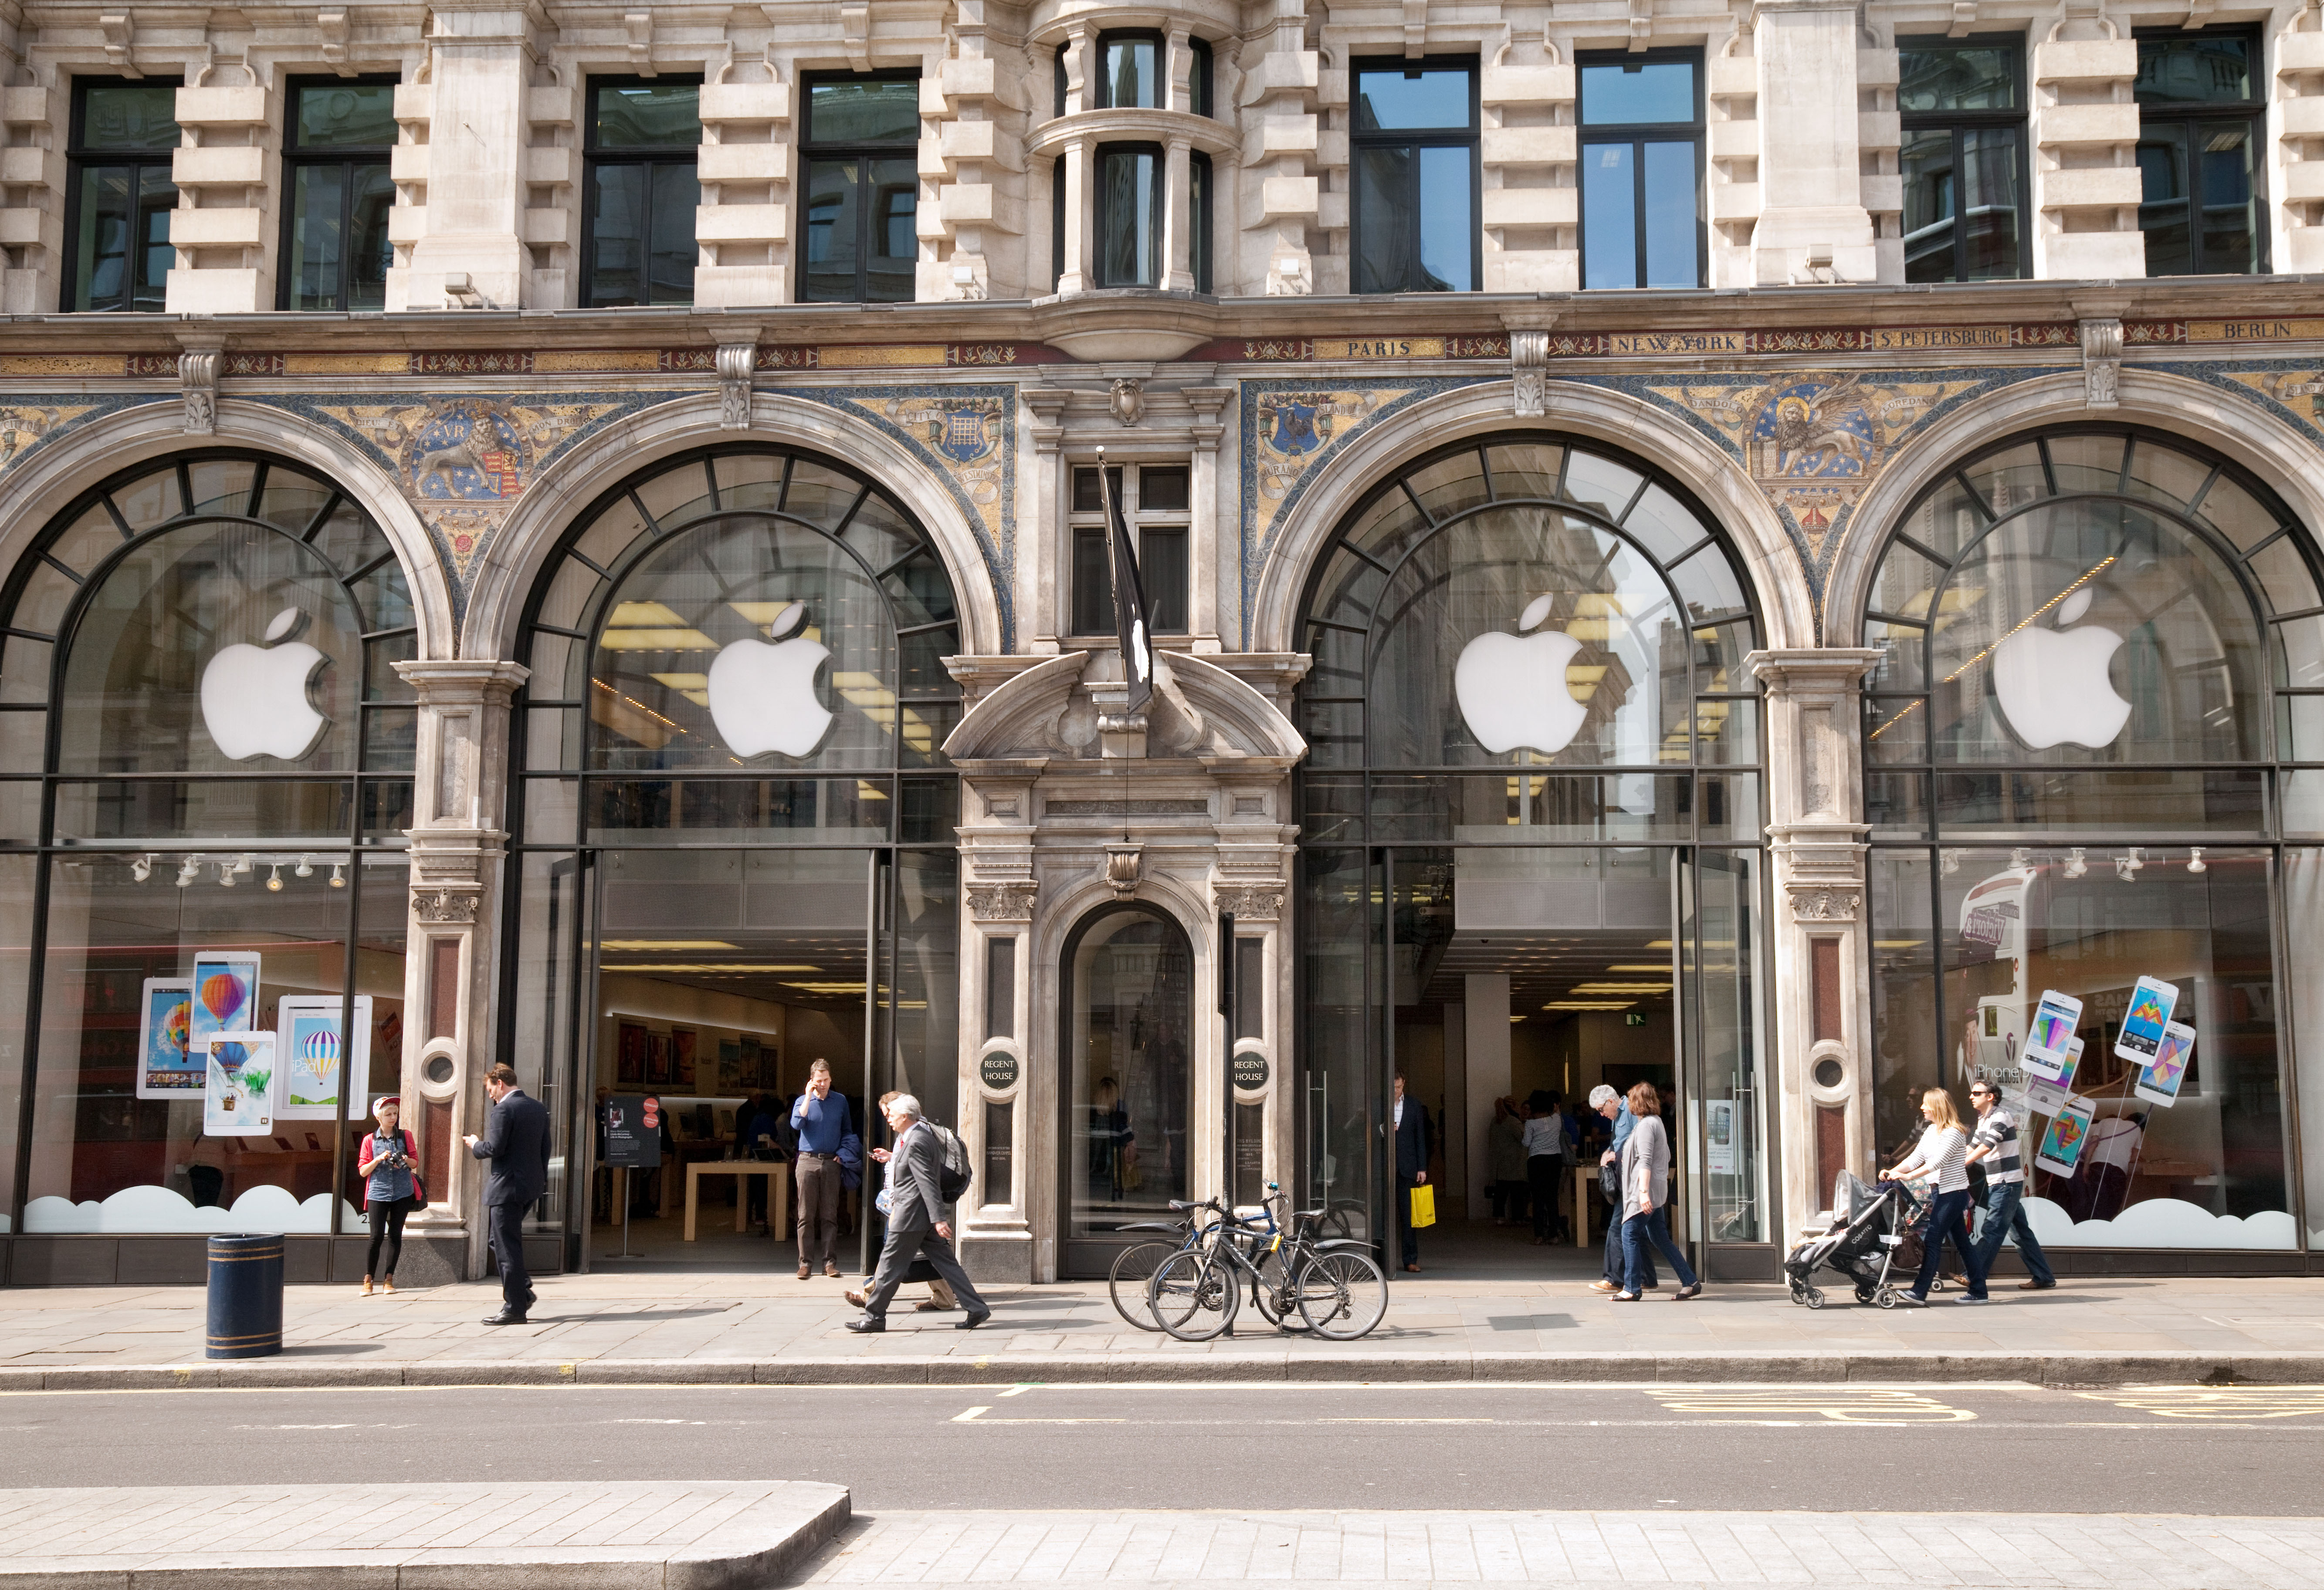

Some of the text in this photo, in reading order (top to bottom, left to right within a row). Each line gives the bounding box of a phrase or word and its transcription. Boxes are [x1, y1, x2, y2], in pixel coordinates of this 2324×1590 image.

[1901, 329, 2002, 345] PETERSBURG
[2225, 323, 2290, 338] BERLIN
[1348, 342, 1410, 356] PARIS
[1618, 336, 1736, 352] NEW YORK
[1690, 399, 1743, 414] DANDOLO
[1883, 397, 1936, 412] LOREDANO
[908, 412, 931, 421] CITY
[4, 420, 21, 430] CITY
[388, 421, 401, 429] ET
[444, 425, 464, 438] VR
[532, 420, 552, 433] MON
[1261, 466, 1299, 480] MURANO
[292, 1059, 317, 1073] iPad
[1975, 1064, 2021, 1077] iPhone
[1851, 1225, 1872, 1244] COSATTO
